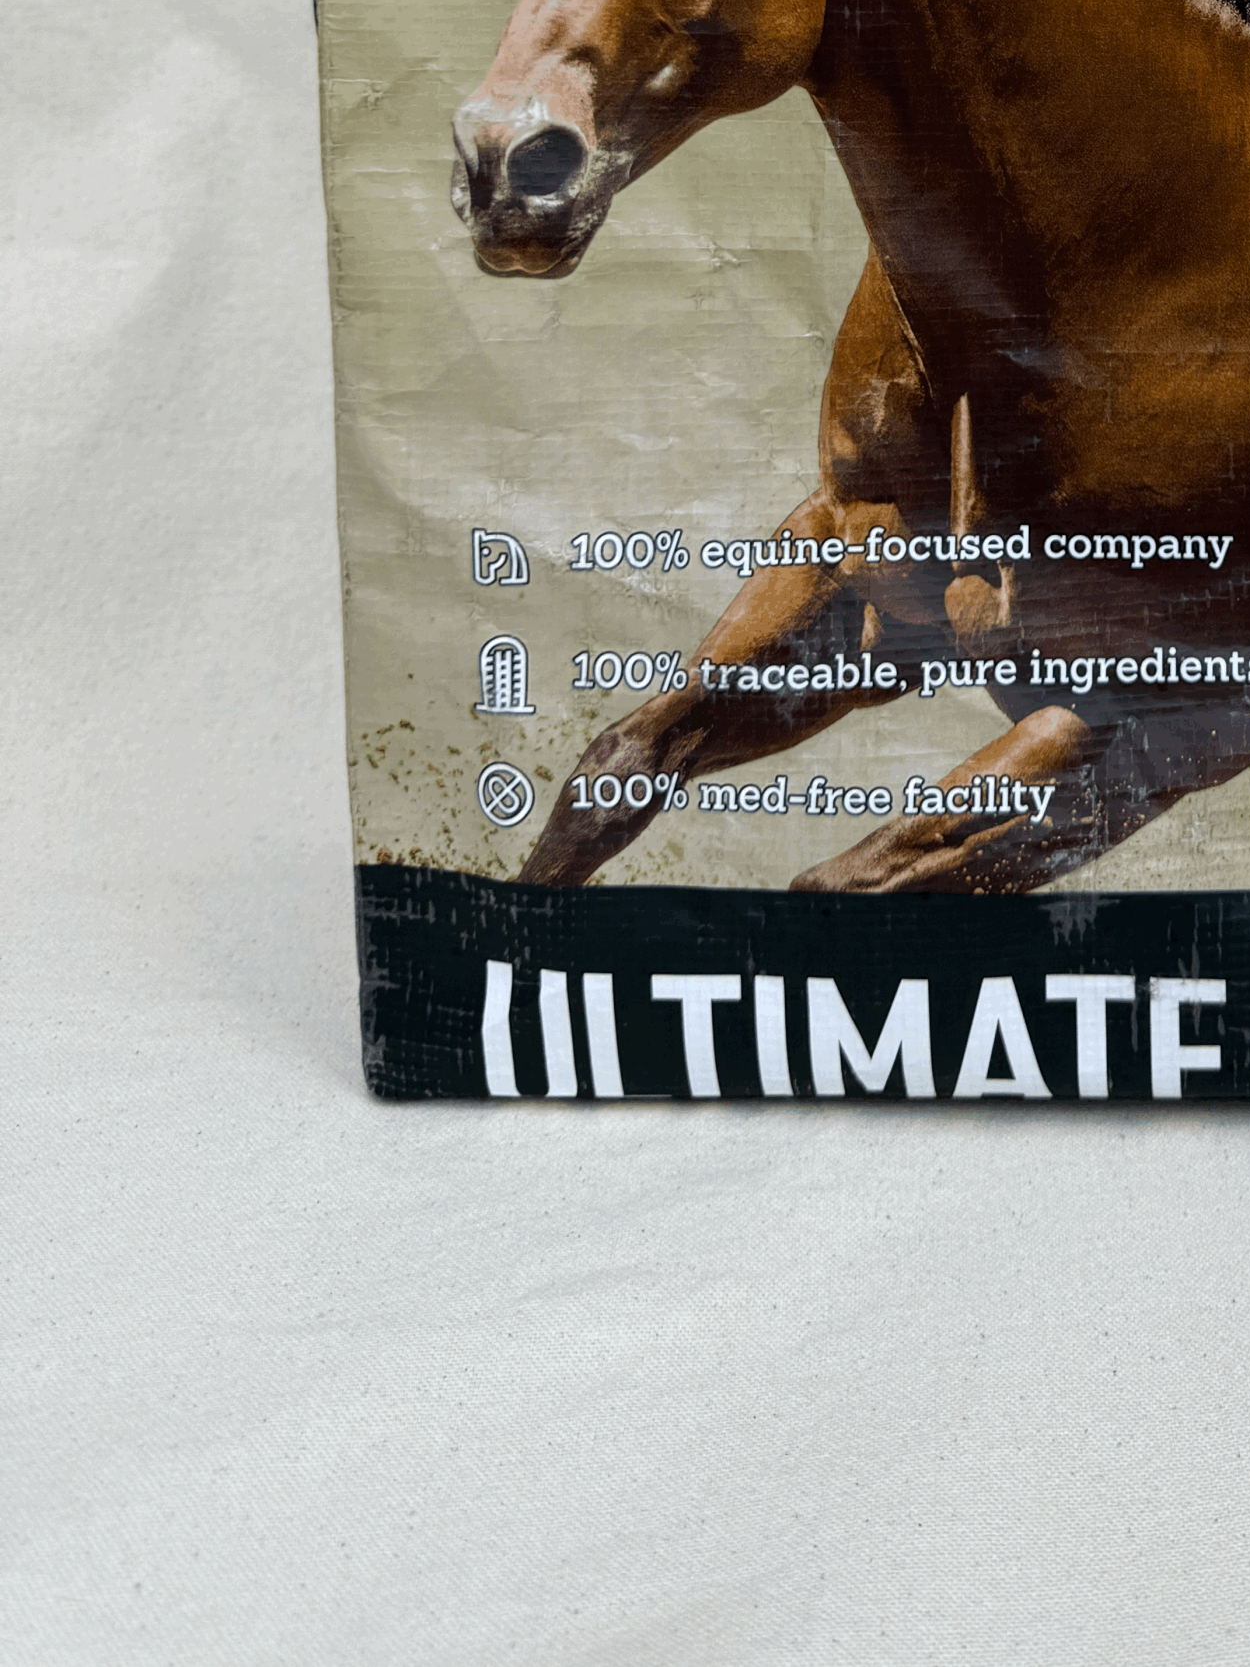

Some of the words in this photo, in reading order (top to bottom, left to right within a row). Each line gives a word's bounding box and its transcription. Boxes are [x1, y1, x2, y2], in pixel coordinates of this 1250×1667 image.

[569, 529, 690, 572] 100%
[700, 524, 1032, 577] equine-focused
[1043, 533, 1234, 569] company
[571, 650, 688, 693] 100%
[699, 650, 908, 693] traceable,
[919, 657, 1018, 697] pure
[569, 771, 688, 811] 100%
[698, 775, 893, 815] med-free
[902, 774, 1056, 822] facility
